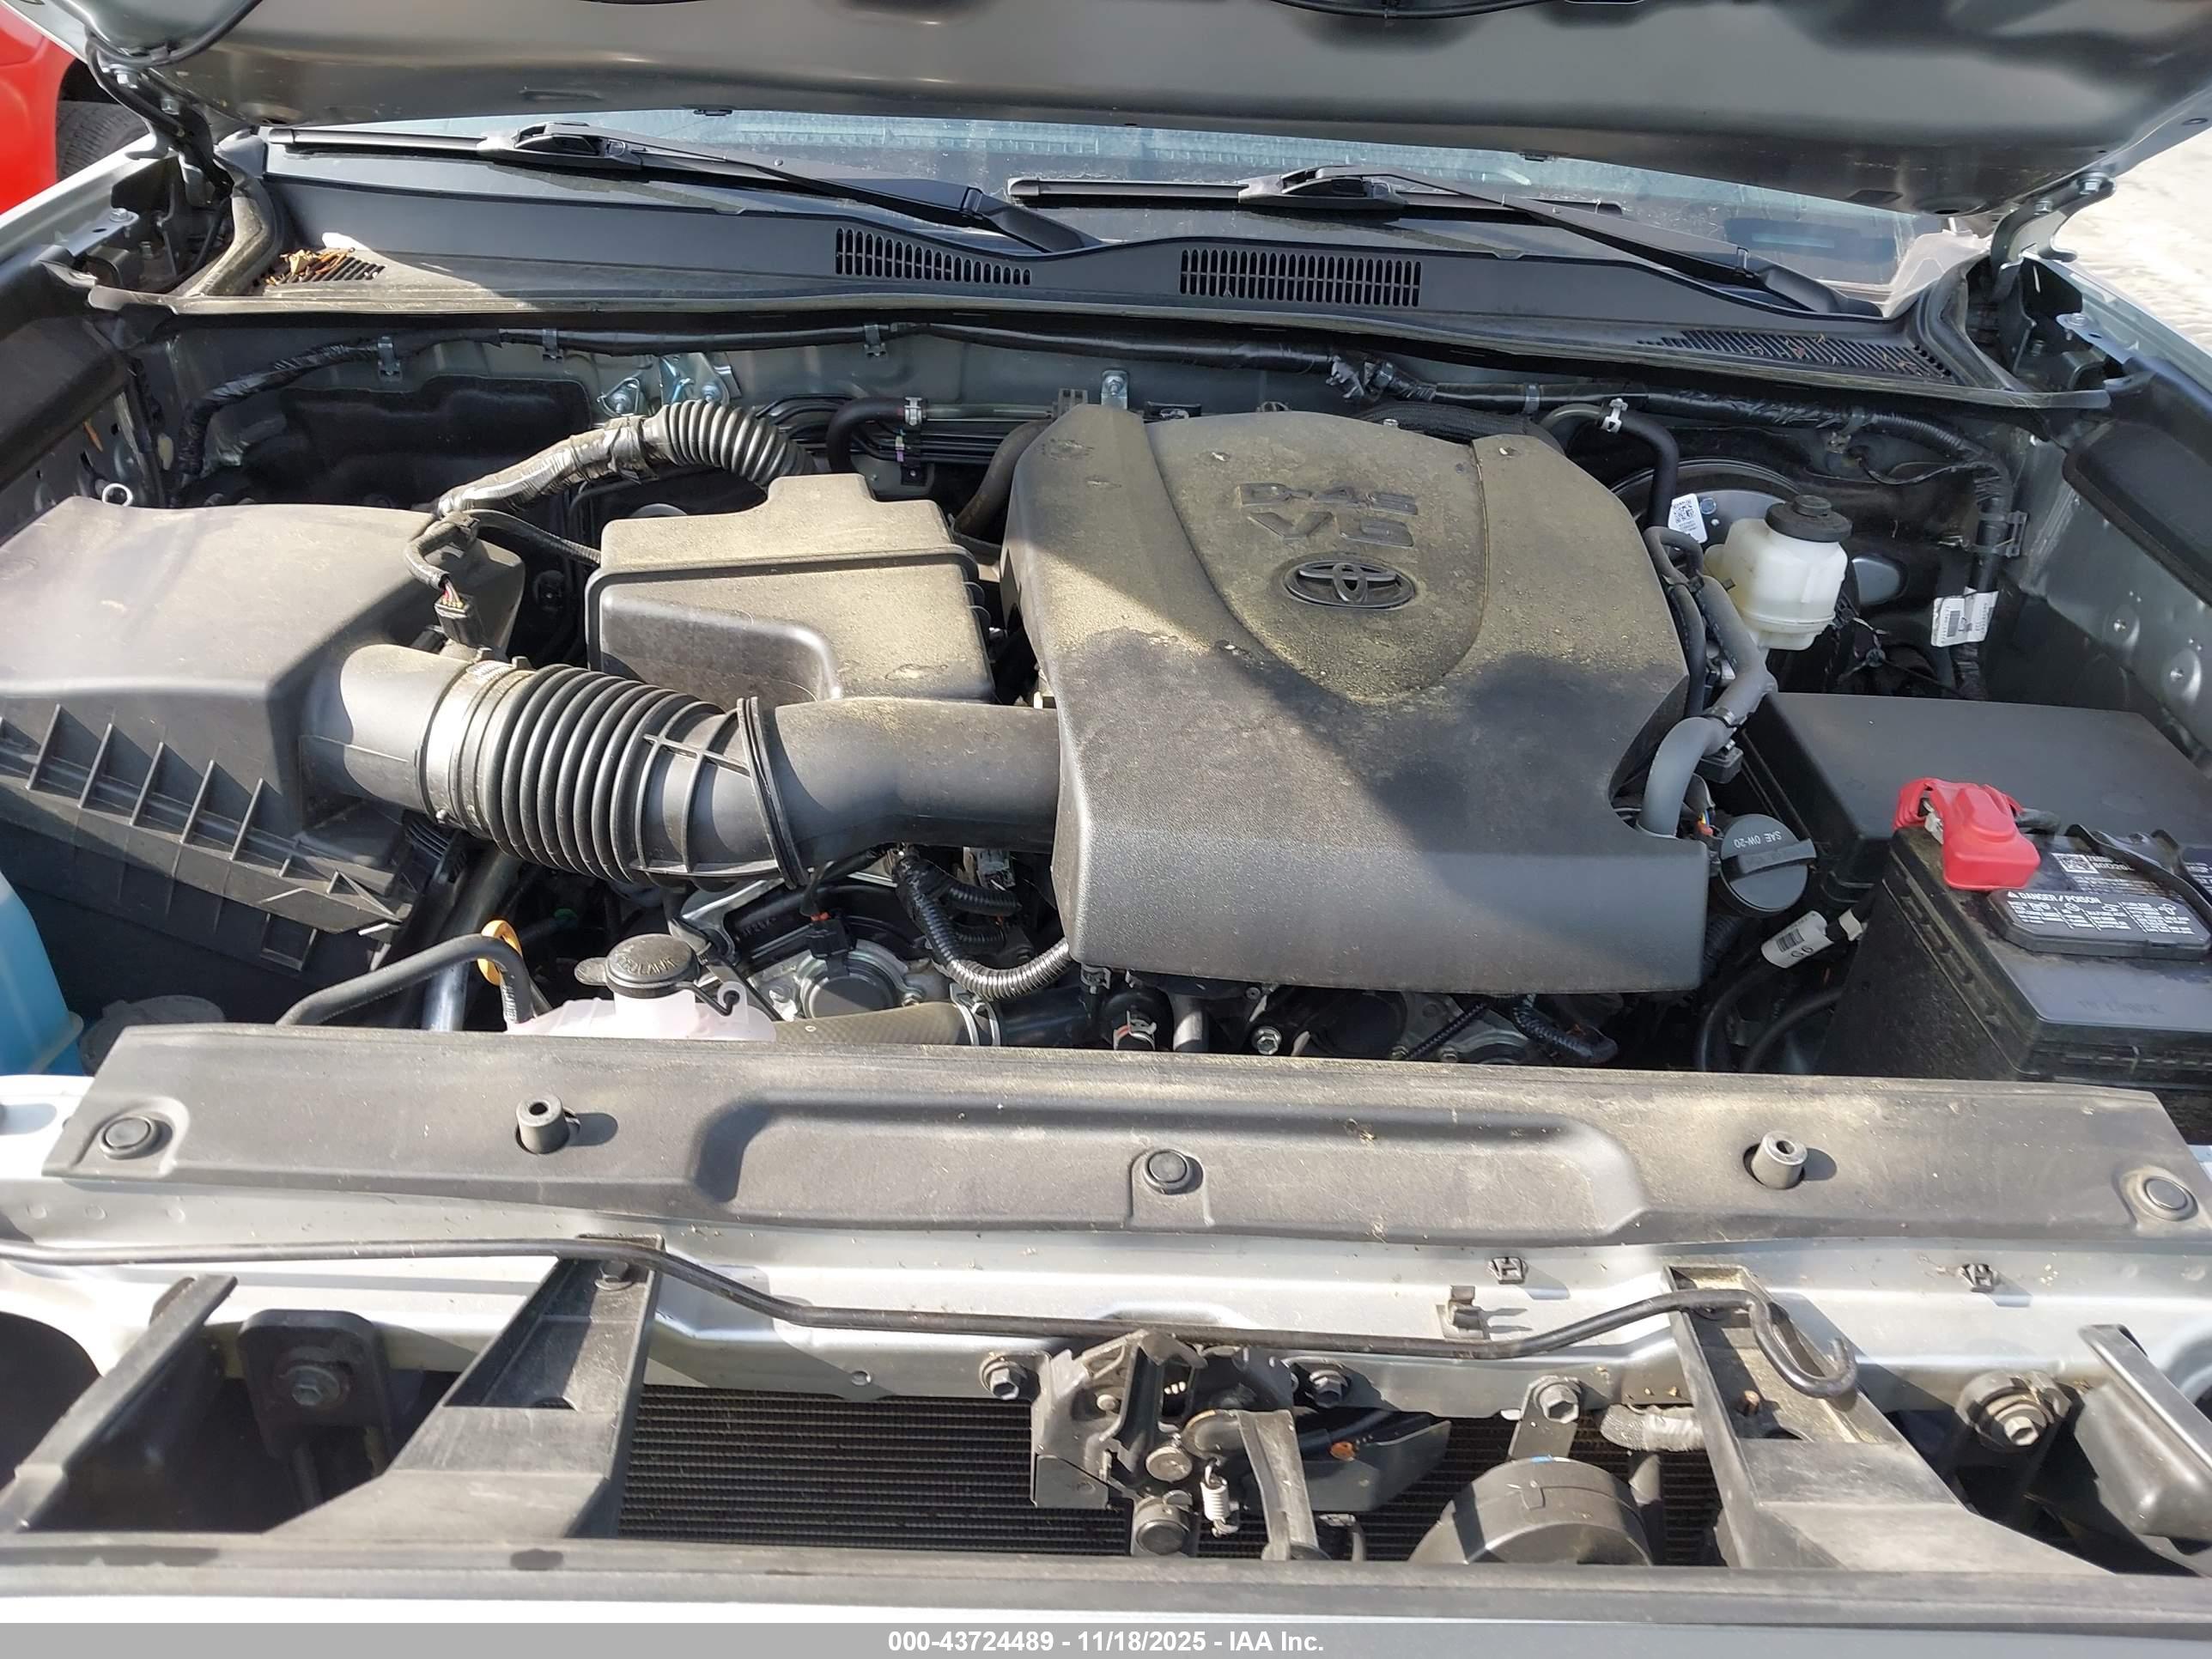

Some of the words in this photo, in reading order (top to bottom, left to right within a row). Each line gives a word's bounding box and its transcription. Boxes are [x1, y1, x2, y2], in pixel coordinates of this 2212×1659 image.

[1247, 512, 1415, 549] V6
[1763, 830, 1783, 843] SAE
[2018, 891, 2057, 902] DANGER
[2063, 893, 2102, 904] POISON
